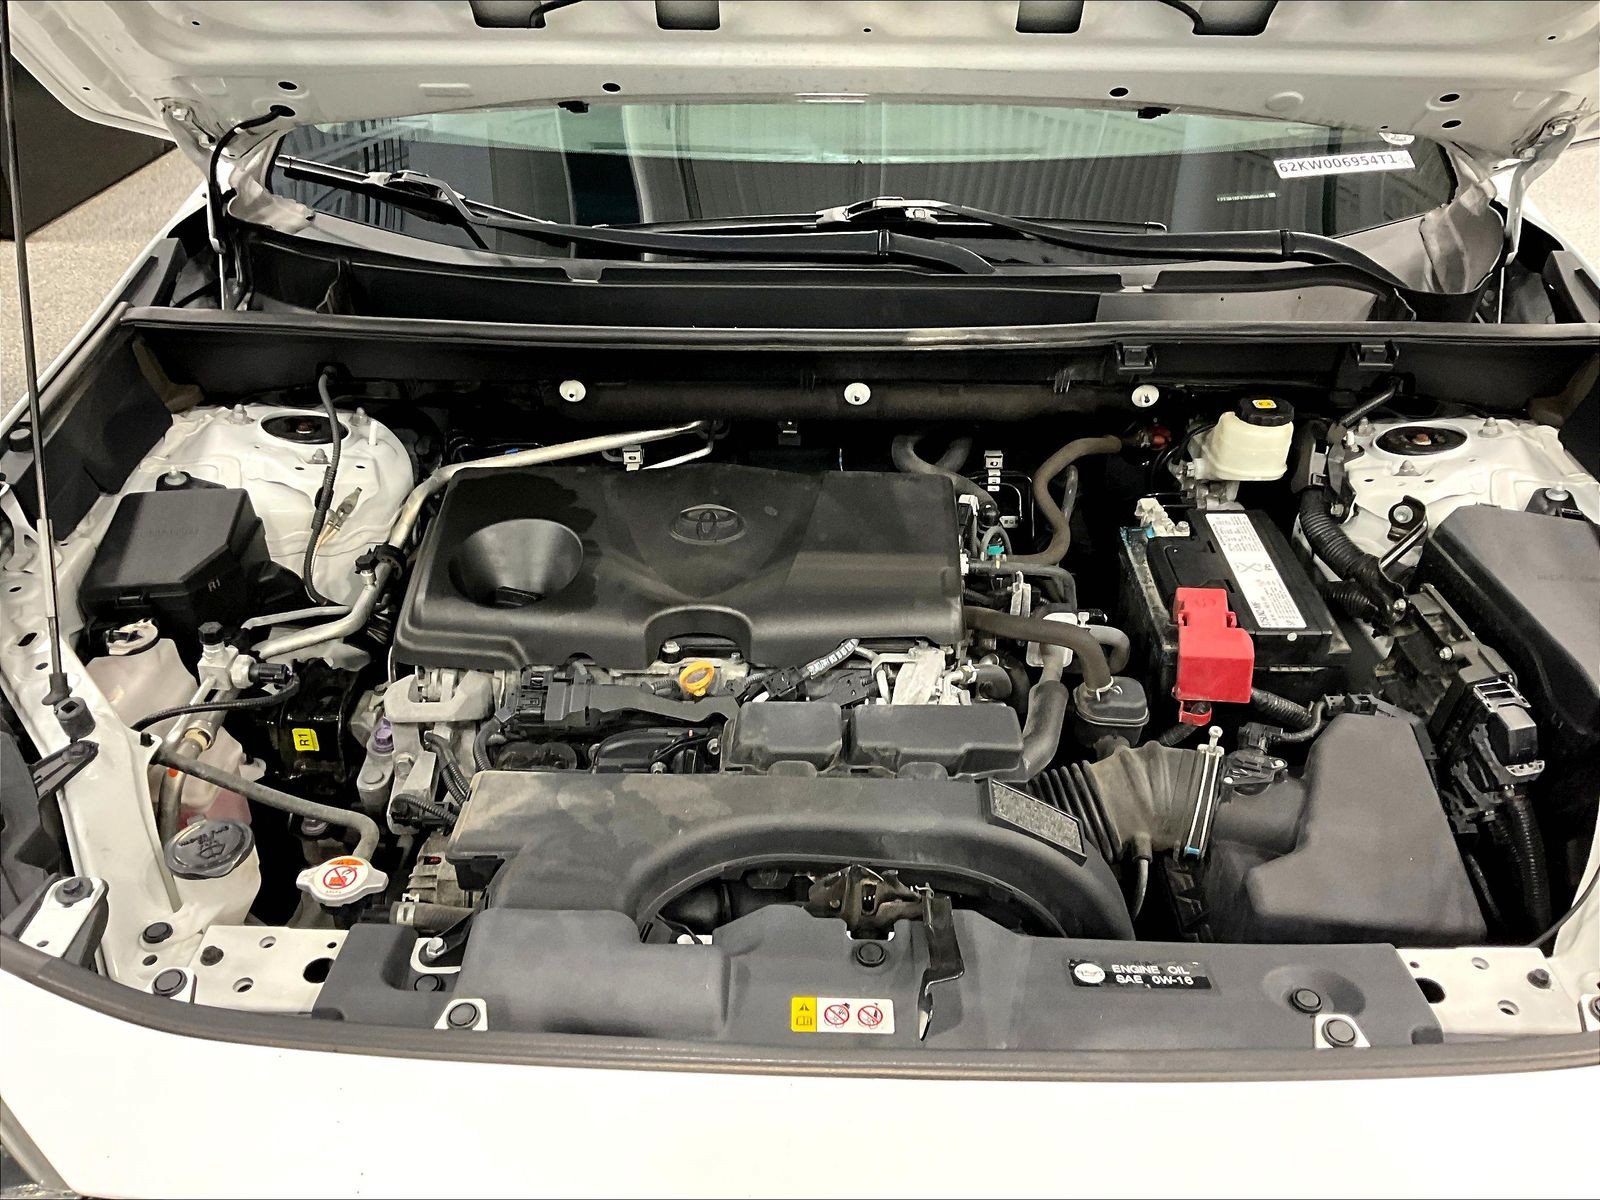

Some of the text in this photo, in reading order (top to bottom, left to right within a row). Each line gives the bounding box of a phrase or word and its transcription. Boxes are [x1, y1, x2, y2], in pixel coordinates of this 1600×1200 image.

[1278, 154, 1398, 173] 62KW006954T1
[298, 733, 311, 746] R1
[1111, 964, 1191, 975] ENGINE OIL
[1115, 974, 1144, 984] SAE
